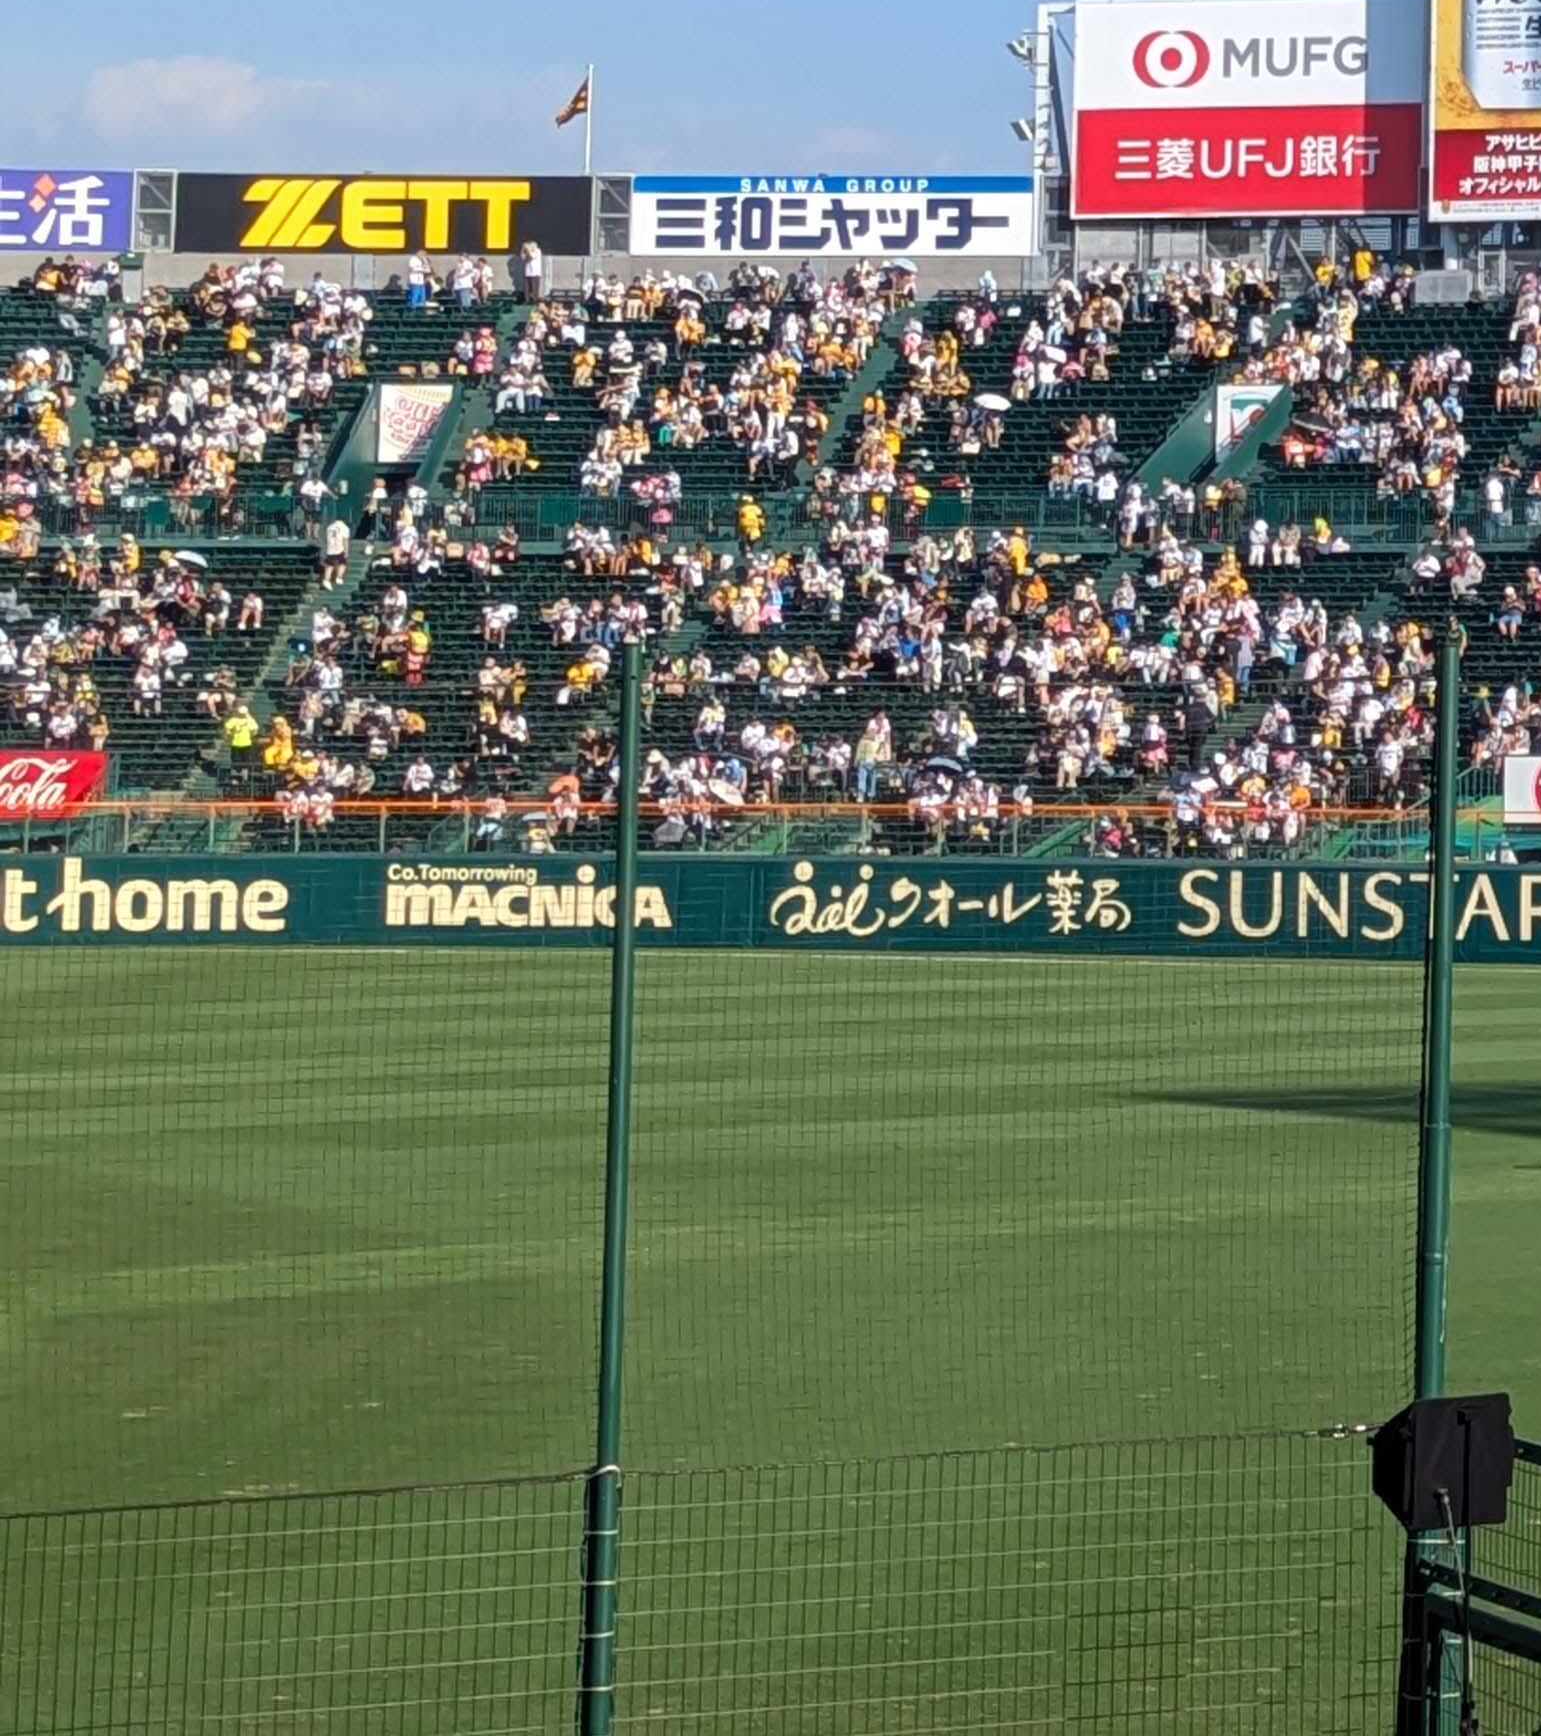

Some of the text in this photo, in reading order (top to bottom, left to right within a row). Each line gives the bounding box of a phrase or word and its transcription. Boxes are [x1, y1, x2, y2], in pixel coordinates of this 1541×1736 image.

[1222, 35, 1370, 78] MUFG
[1114, 133, 1381, 180] 三菱UFJ銀行
[740, 177, 930, 193] SANWA GROUP
[239, 179, 531, 249] ZETT
[655, 195, 1010, 251] 三和シャッター
[46, 856, 289, 933] home
[387, 863, 538, 886] Co.Tomorrowing
[887, 868, 1132, 936] クオール薬局
